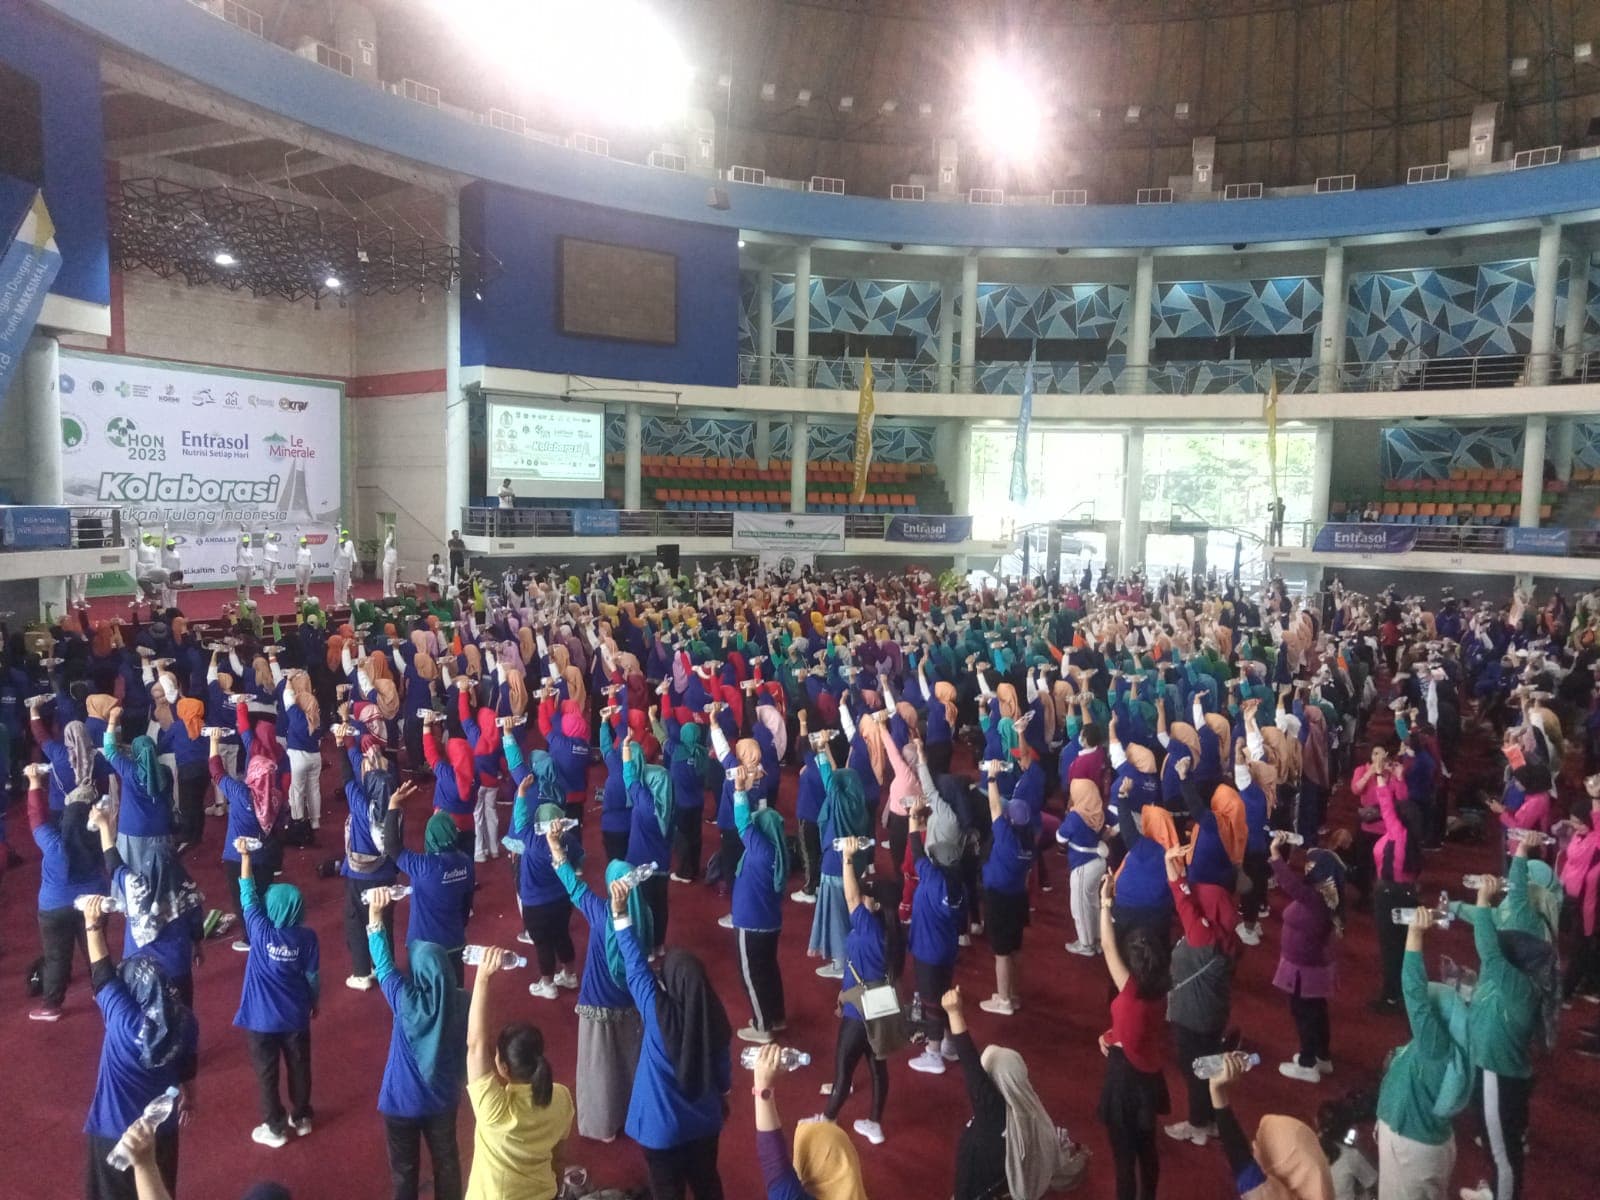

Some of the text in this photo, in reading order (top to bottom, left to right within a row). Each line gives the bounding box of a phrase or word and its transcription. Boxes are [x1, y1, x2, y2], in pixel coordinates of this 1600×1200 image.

[15, 263, 49, 316] MAKSIMAL
[128, 434, 165, 448] HON
[181, 430, 249, 450] Entrasol
[290, 434, 303, 447] Le
[128, 448, 166, 461] 2023
[182, 449, 208, 457] Nutrisi
[209, 450, 233, 459] Setiap
[269, 444, 316, 459] Minerale
[98, 472, 281, 503] Kolaborasi
[163, 508, 215, 522] Tulang
[220, 510, 288, 521] Indonesia
[903, 523, 946, 534] Entrasol
[1334, 531, 1387, 543] Entrasol
